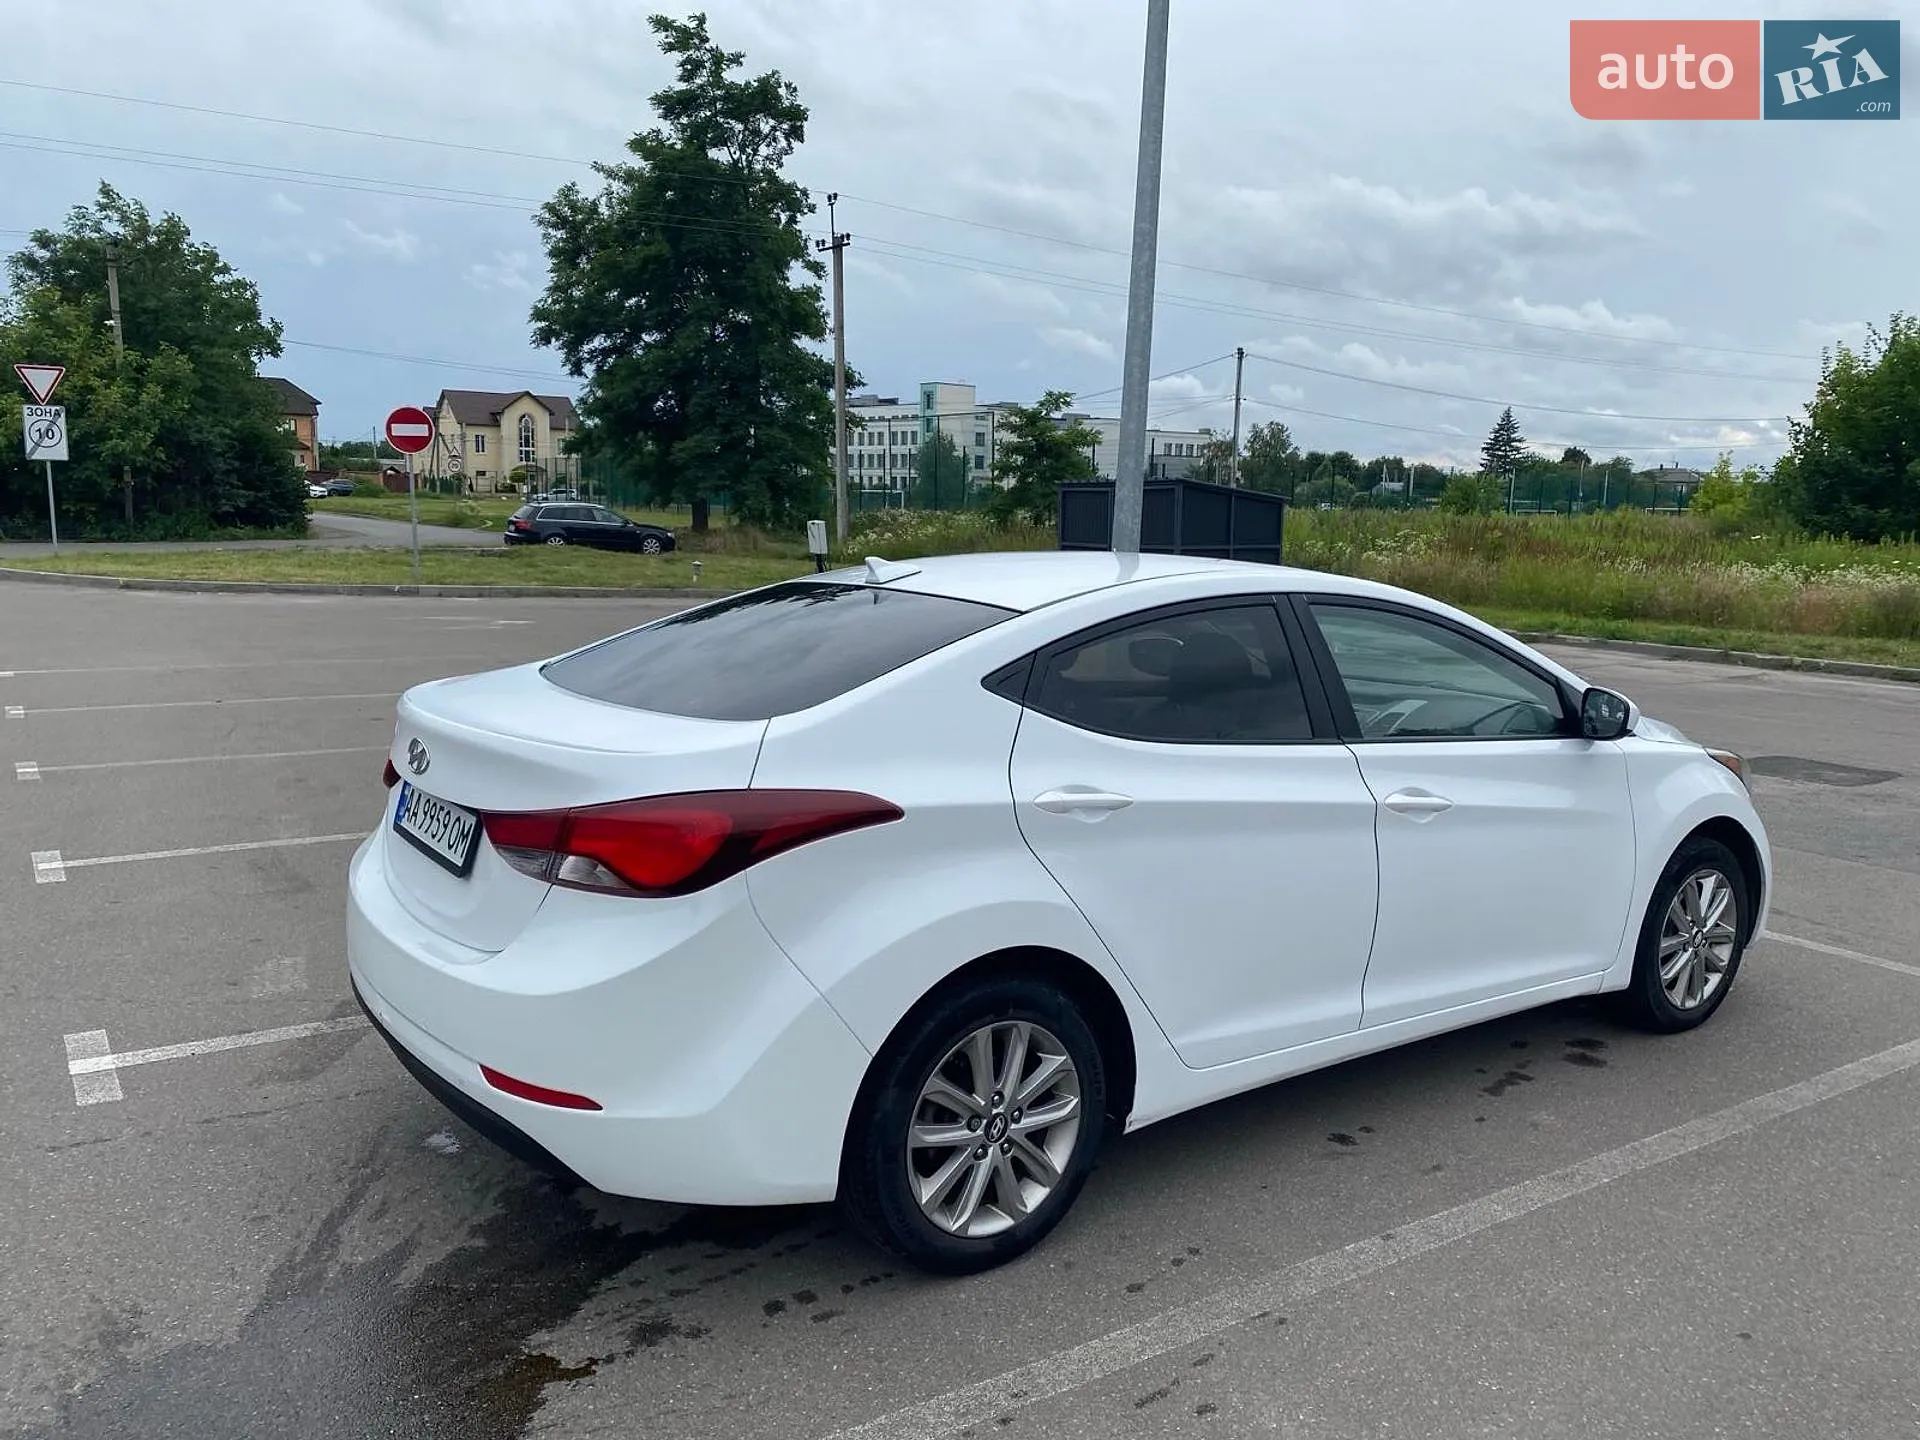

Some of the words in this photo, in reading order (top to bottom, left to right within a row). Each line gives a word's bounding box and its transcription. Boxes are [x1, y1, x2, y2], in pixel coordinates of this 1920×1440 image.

[26, 406, 62, 418] ЗОНА
[35, 427, 55, 440] 10
[405, 788, 422, 827] AA
[418, 798, 451, 843] 9959
[447, 815, 473, 859] OM
